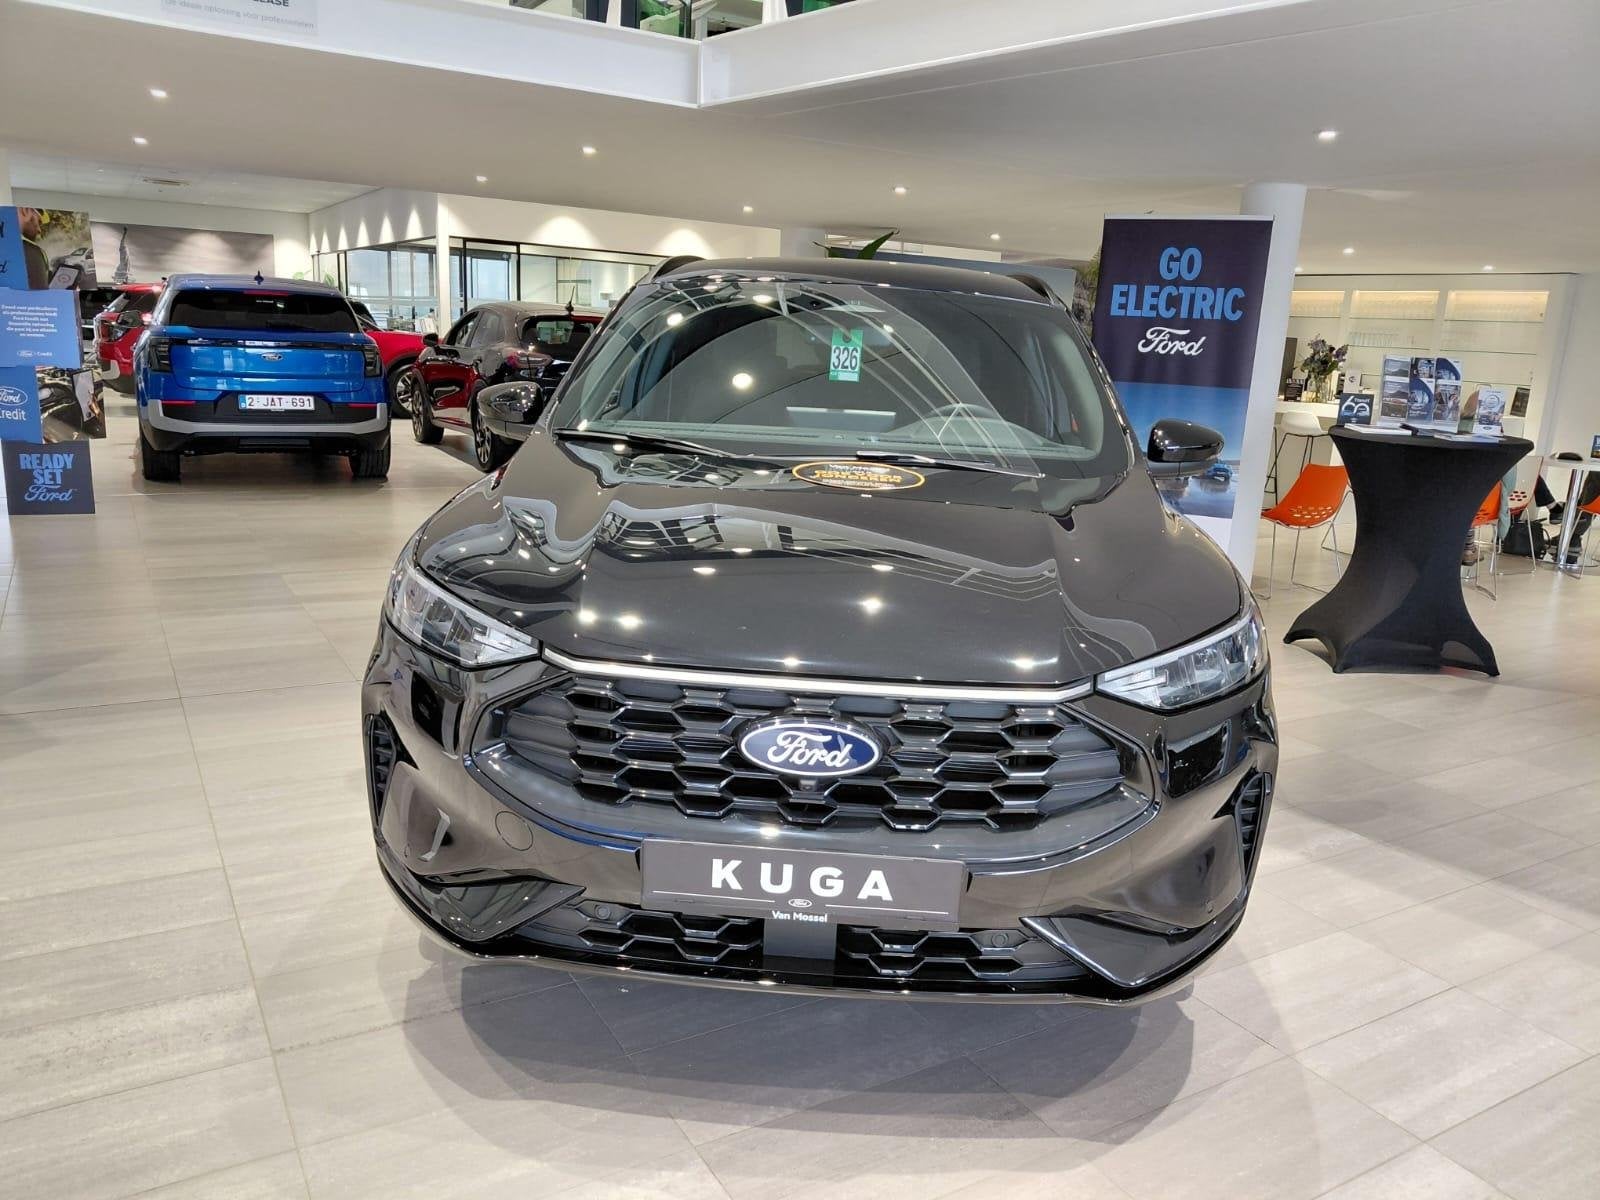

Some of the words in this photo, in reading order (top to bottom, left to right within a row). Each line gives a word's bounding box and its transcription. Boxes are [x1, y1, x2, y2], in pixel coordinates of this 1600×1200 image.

[1159, 247, 1203, 280] GO
[1110, 284, 1245, 321] ELECTRIC
[1137, 326, 1207, 356] Ford
[832, 347, 858, 370] 326
[0, 408, 27, 421] redit
[19, 453, 75, 470] READY
[32, 469, 63, 485] SET
[24, 484, 73, 502] Ford
[766, 730, 854, 768] Ford
[711, 858, 894, 901] KUGA
[771, 910, 791, 920] Van
[792, 912, 828, 923] Mossel
